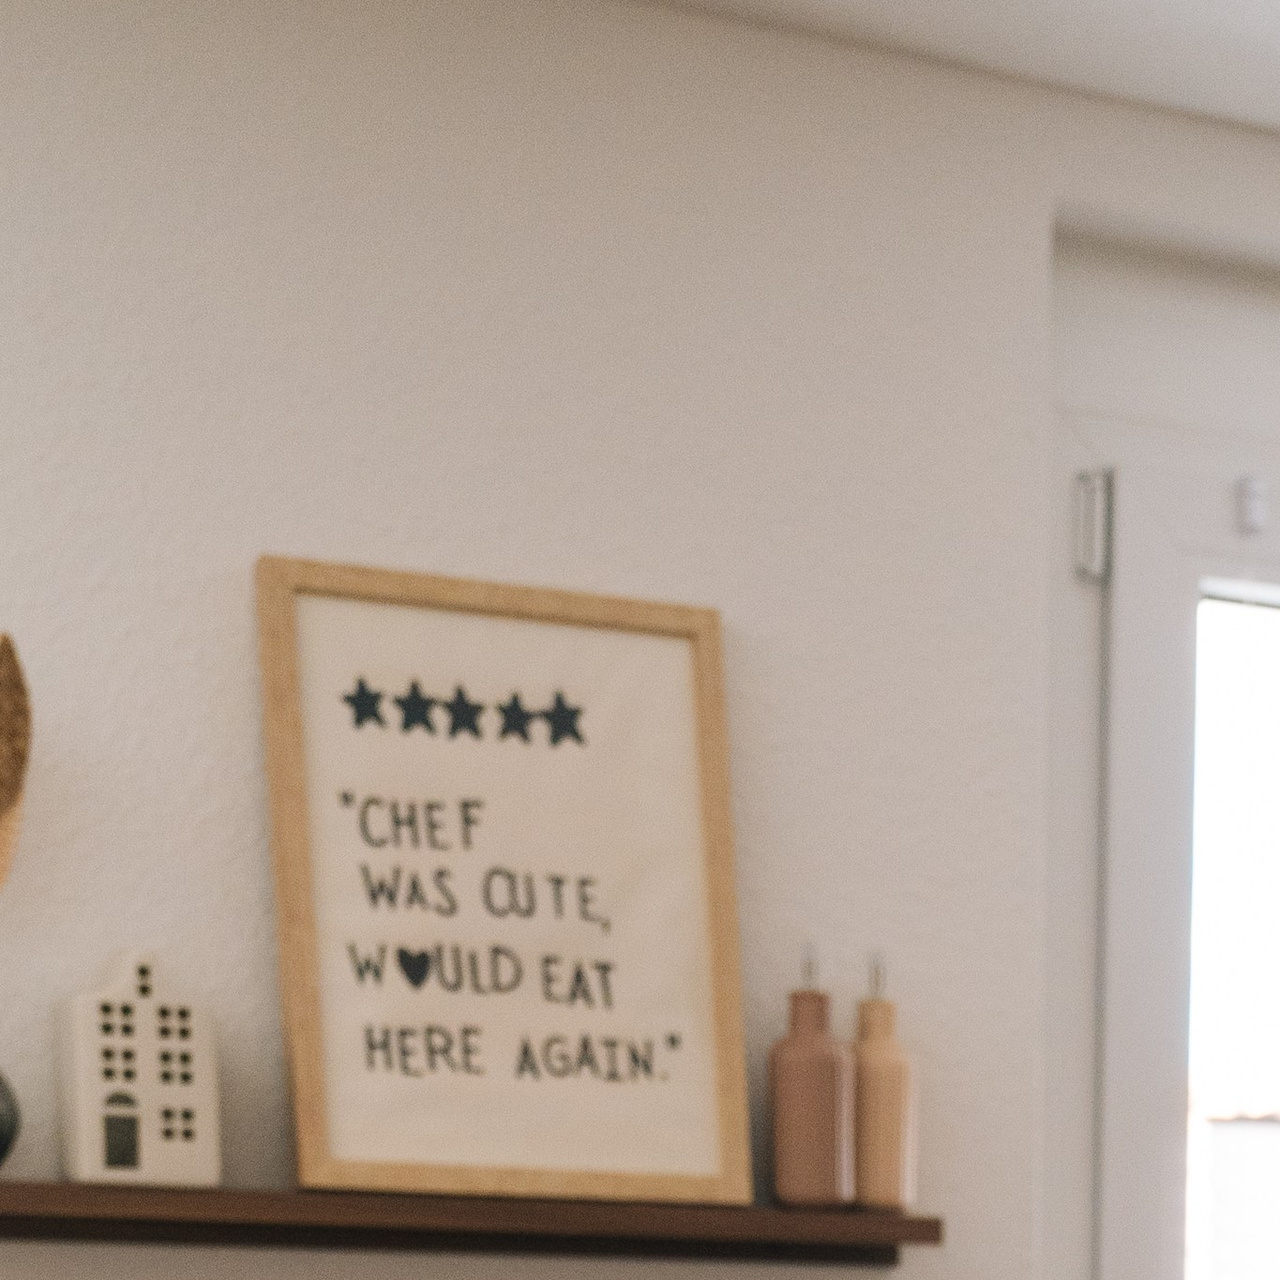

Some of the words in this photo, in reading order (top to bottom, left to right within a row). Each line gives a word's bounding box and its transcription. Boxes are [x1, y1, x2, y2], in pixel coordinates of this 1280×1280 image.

[359, 864, 458, 918] WAS
[541, 953, 616, 1010] EAT
[365, 1023, 485, 1077] HERE
